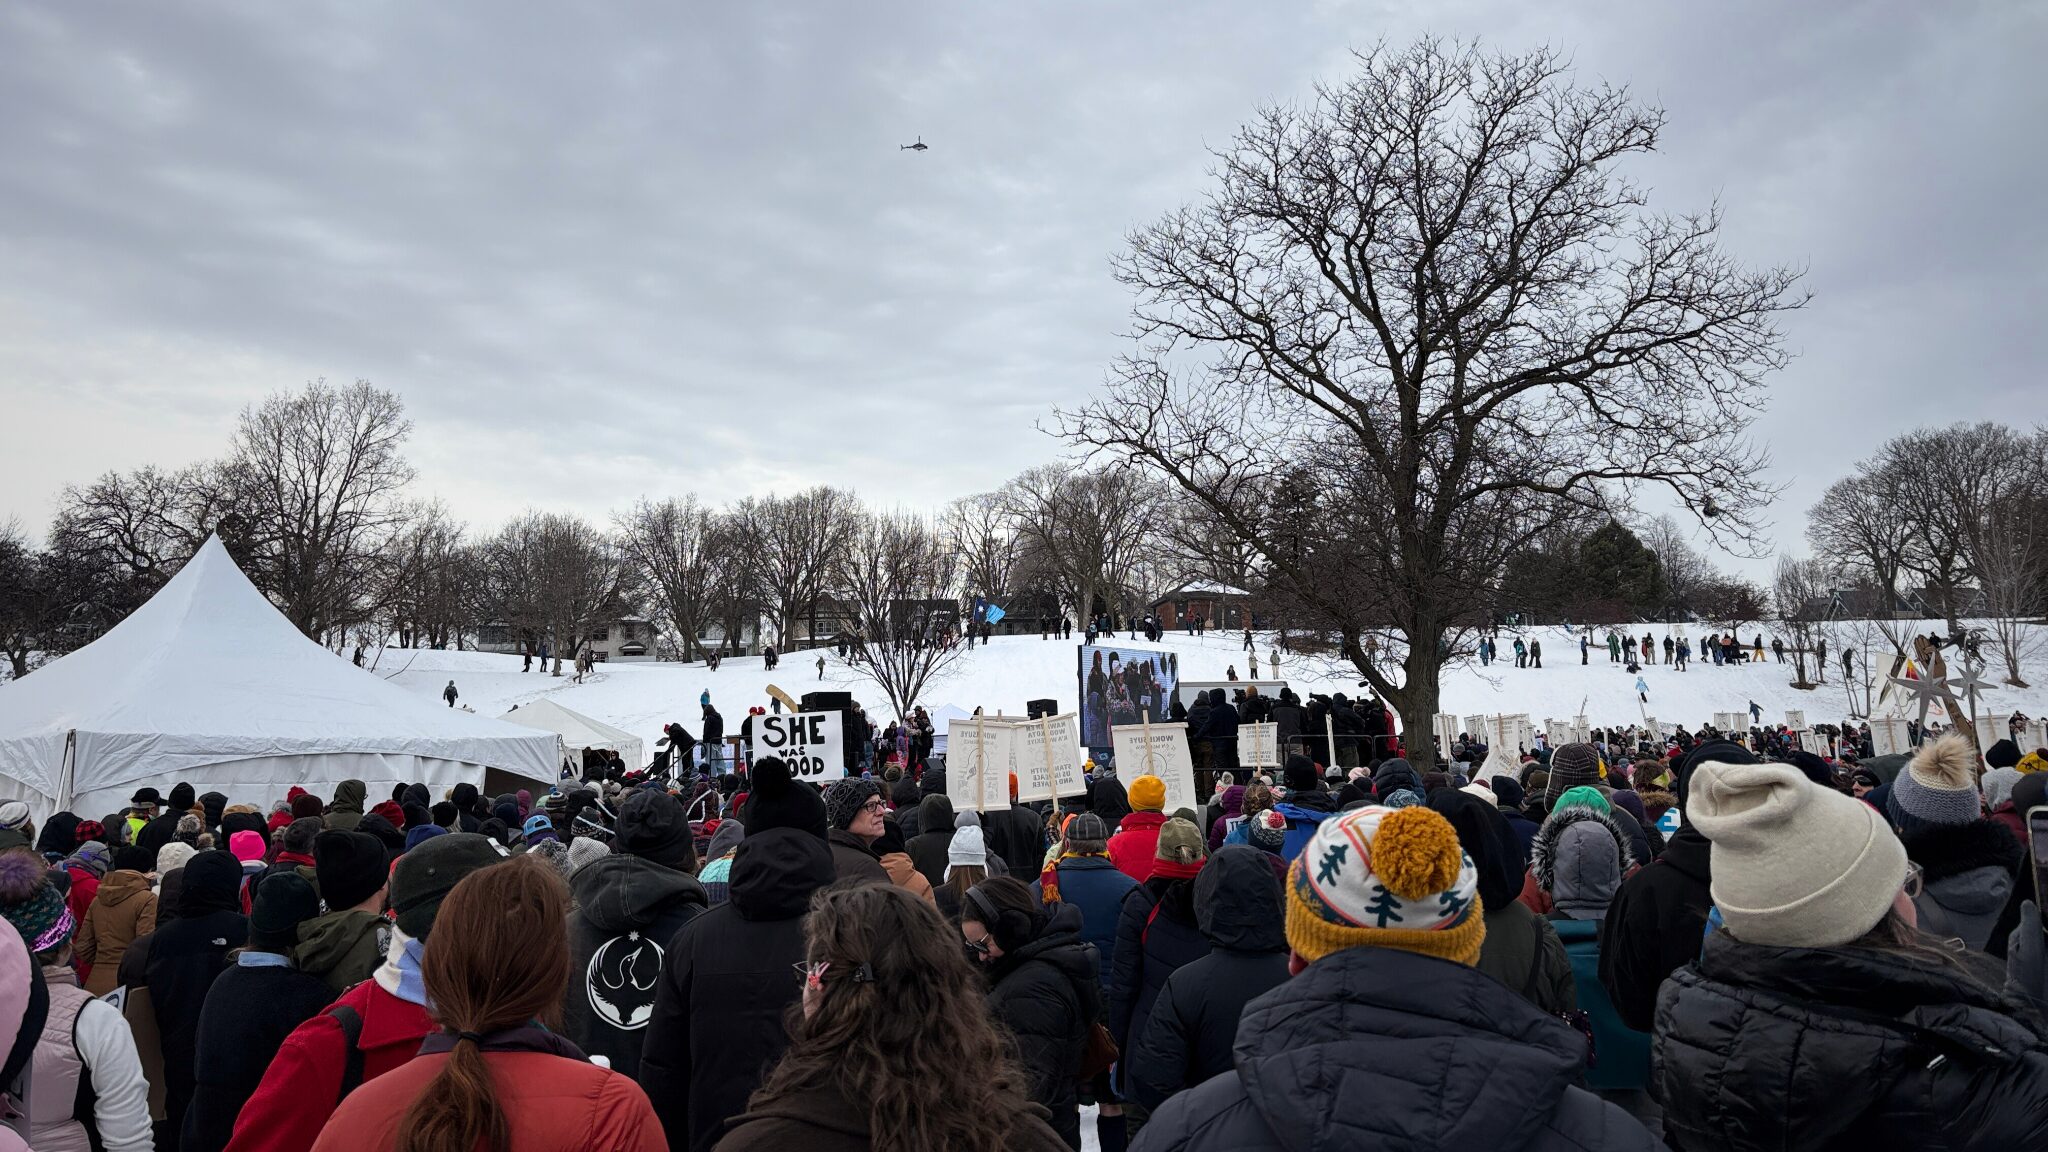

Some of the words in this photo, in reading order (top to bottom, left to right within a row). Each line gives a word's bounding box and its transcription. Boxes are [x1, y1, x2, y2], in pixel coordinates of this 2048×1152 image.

[761, 714, 826, 748] SHE
[778, 746, 806, 758] WAS
[785, 756, 825, 778] OOD
